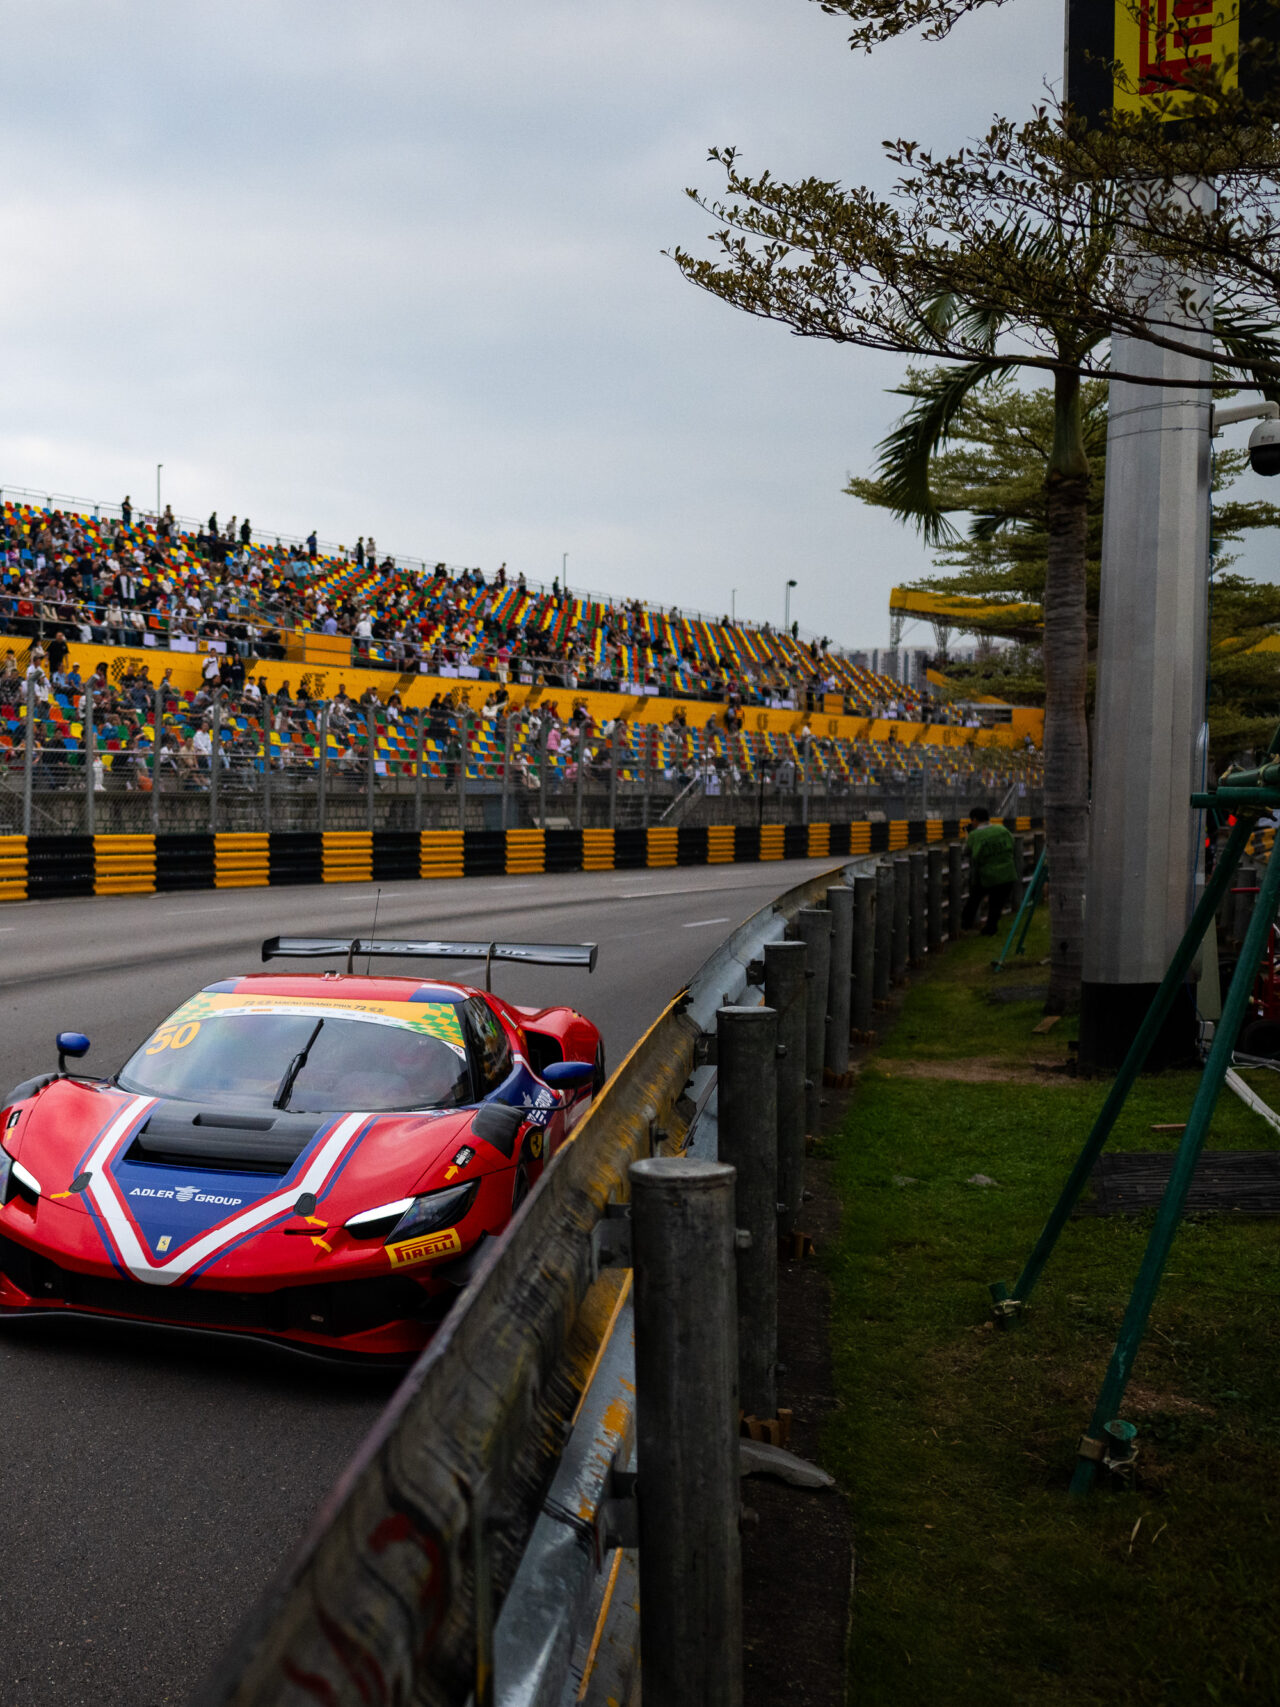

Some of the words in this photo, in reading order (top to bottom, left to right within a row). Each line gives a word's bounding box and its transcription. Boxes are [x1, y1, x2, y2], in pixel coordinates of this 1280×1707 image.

[145, 1021, 201, 1056] 50
[128, 1187, 175, 1199] ADLER
[194, 1193, 242, 1206] GROUP
[394, 1233, 455, 1263] PIRELLI
